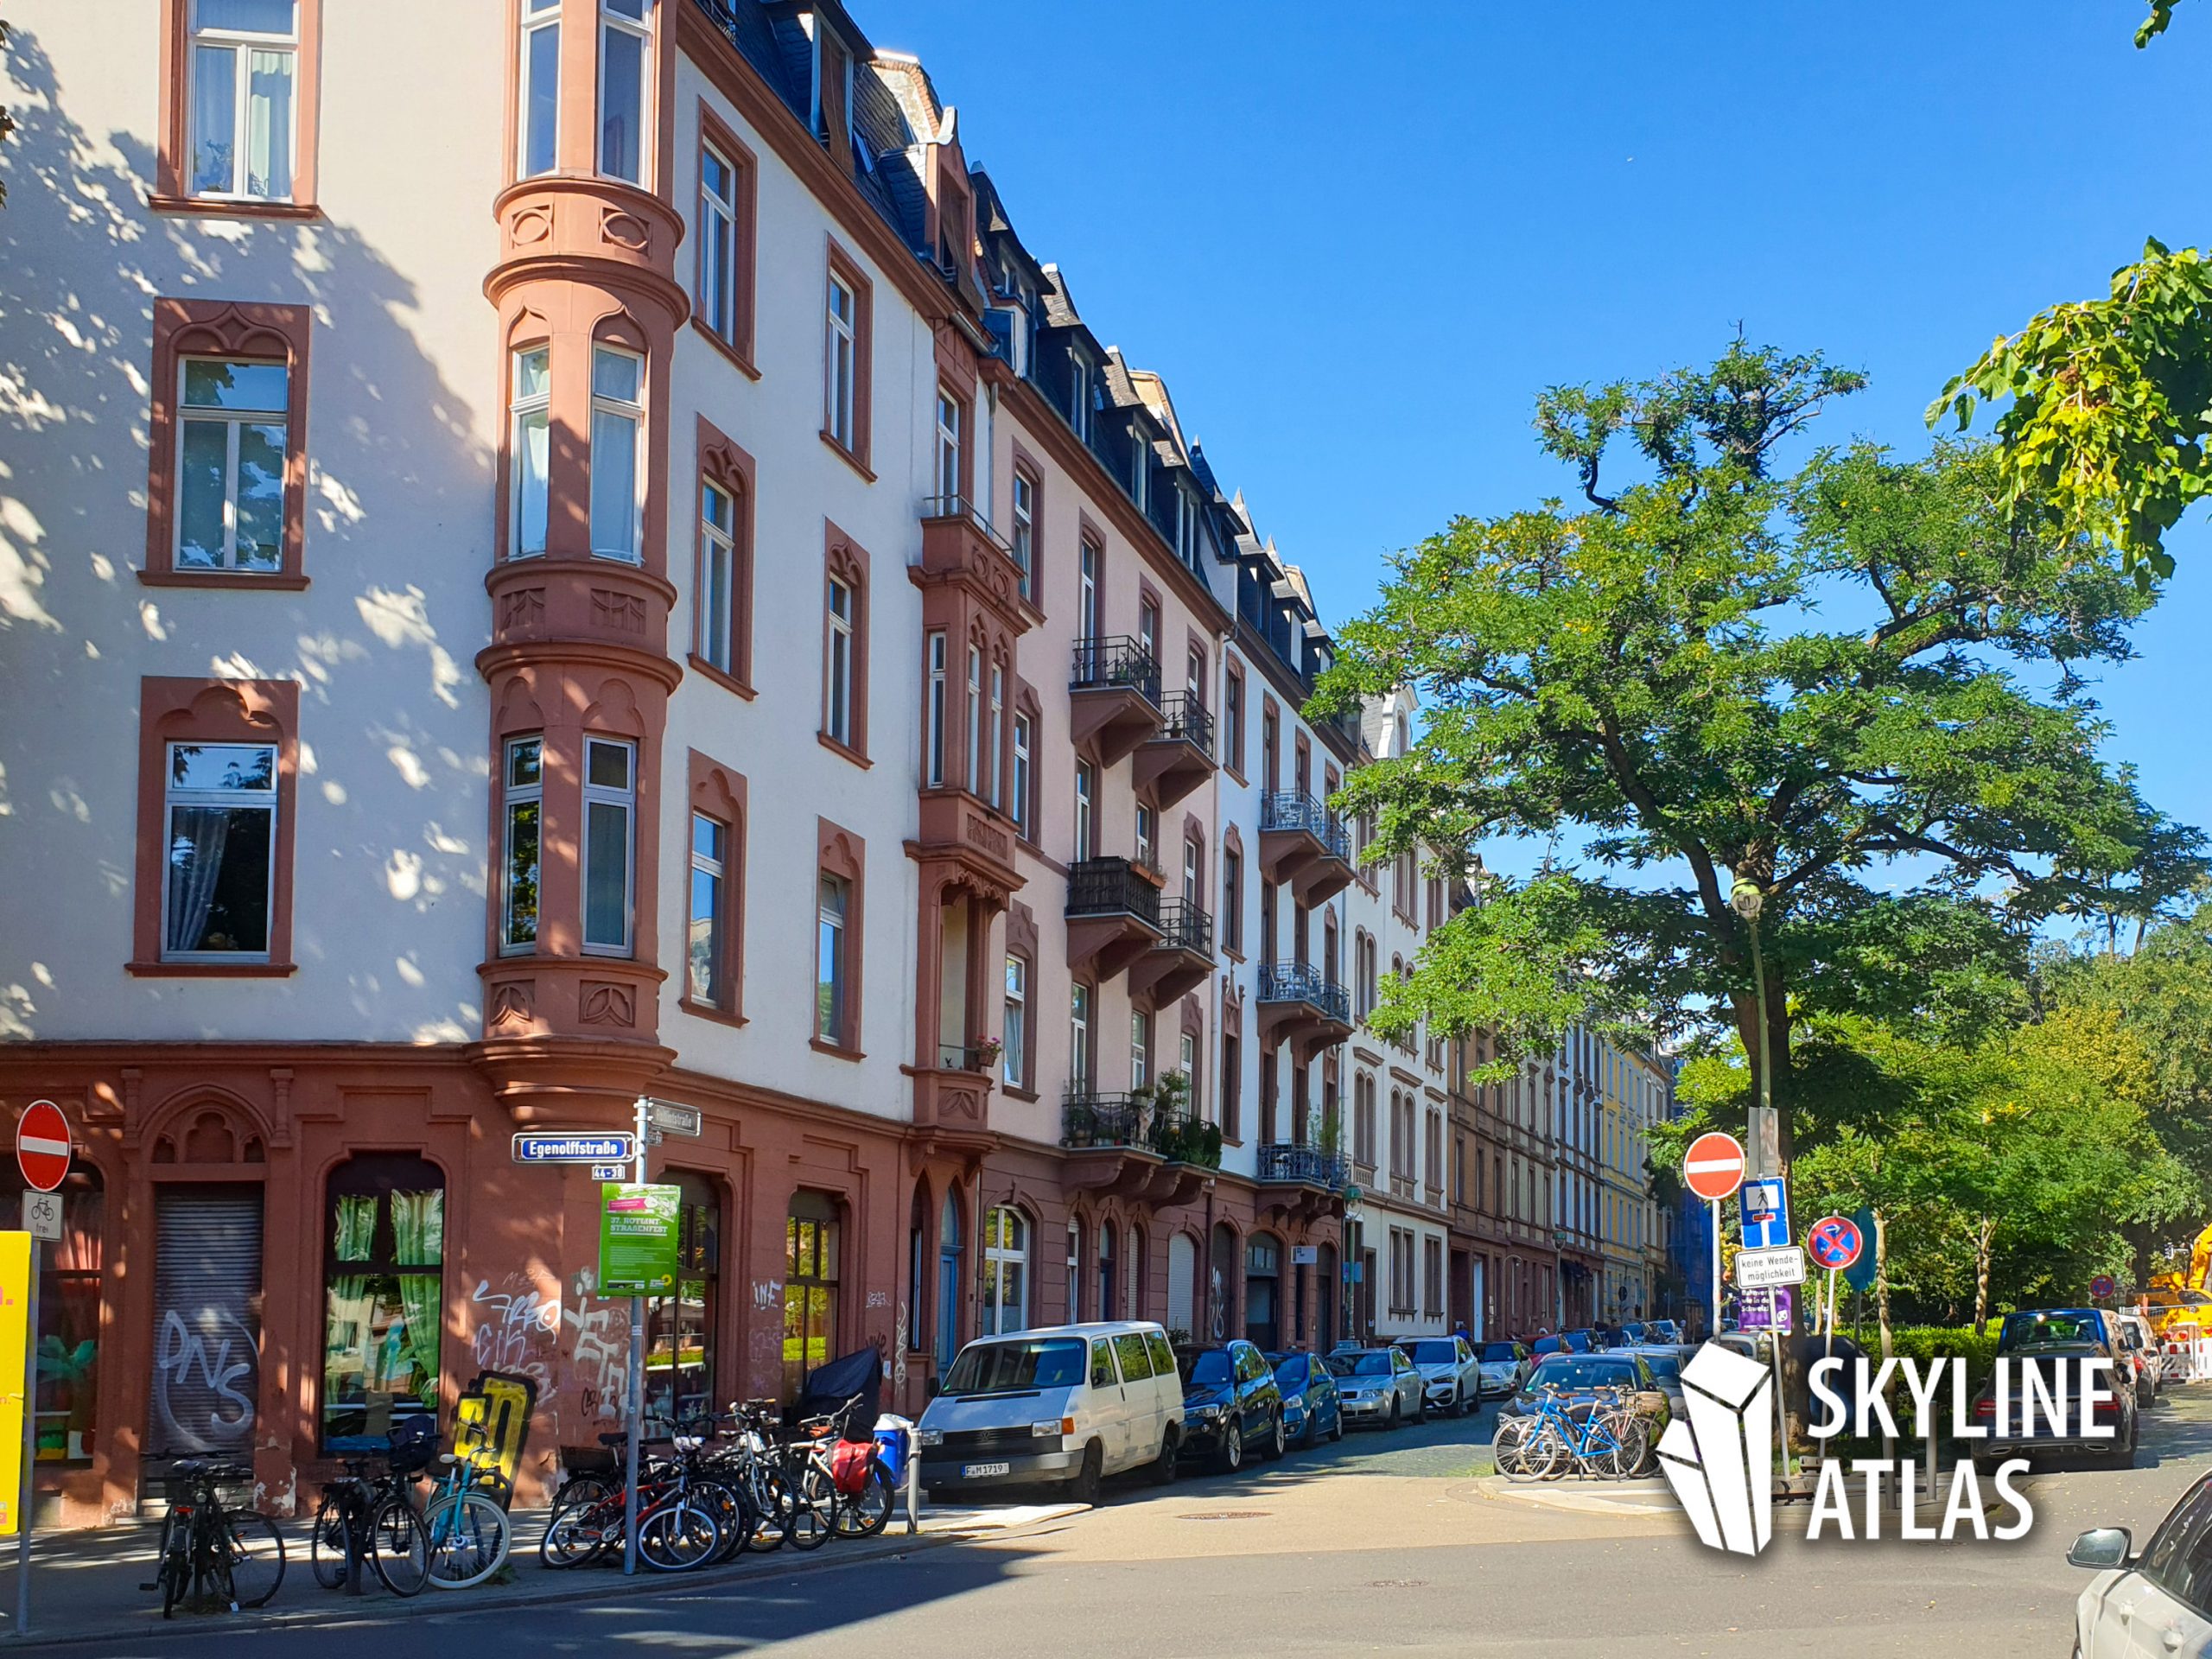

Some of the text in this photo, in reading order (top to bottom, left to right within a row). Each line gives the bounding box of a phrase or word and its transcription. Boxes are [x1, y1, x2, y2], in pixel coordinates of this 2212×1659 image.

[529, 1141, 619, 1159] Egenolffstraße
[594, 1167, 623, 1179] 44-30
[35, 1223, 49, 1234] frei
[1741, 1255, 1798, 1268] keine Wende-
[1747, 1268, 1796, 1282] möglichkeit
